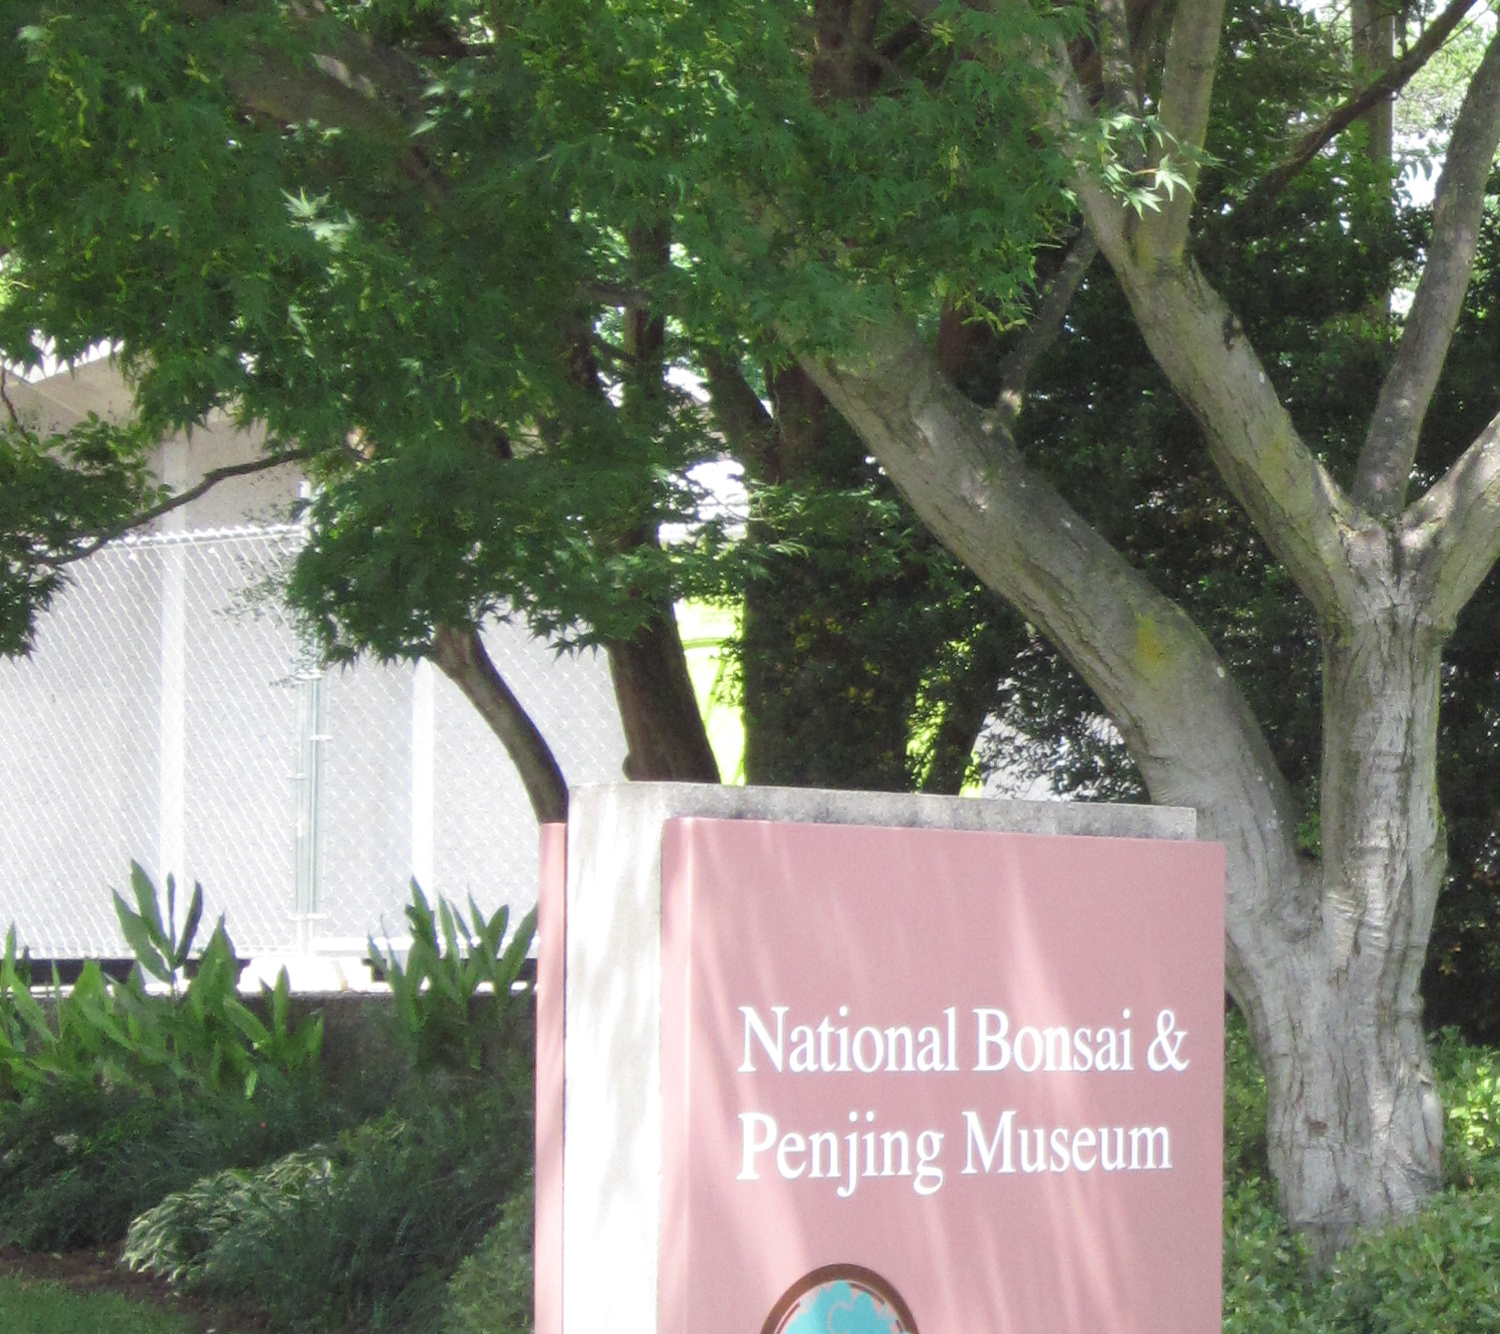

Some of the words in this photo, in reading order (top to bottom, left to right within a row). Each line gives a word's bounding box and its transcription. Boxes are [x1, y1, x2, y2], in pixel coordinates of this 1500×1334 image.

[738, 1005, 959, 1073] National
[972, 1007, 1133, 1072] Bonsai
[1146, 1009, 1190, 1073] &
[736, 1110, 945, 1198] Penjing
[960, 1109, 1173, 1176] Museum
